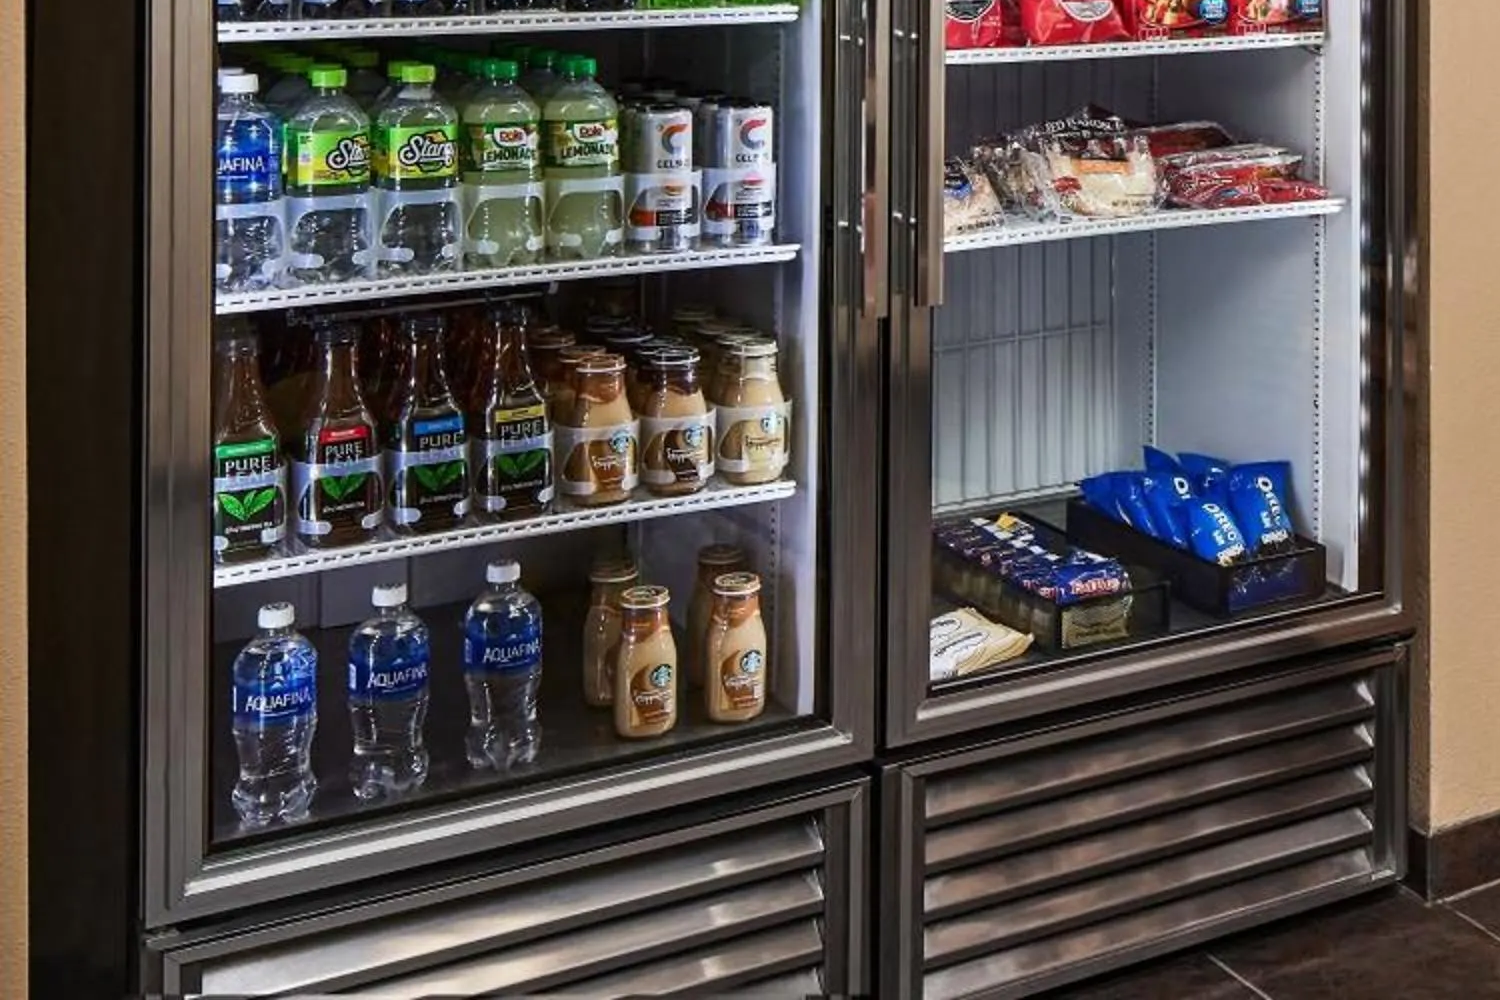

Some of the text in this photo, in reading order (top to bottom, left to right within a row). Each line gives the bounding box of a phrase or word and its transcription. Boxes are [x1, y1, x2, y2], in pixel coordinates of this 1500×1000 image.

[501, 419, 542, 436] PURE
[325, 440, 363, 457] PURE
[419, 431, 463, 449] PURE
[225, 455, 271, 472] PURE
[482, 637, 542, 663] AQUAFINA
[367, 663, 428, 688] AQUAFINA
[245, 686, 313, 712] AQUAFINA
